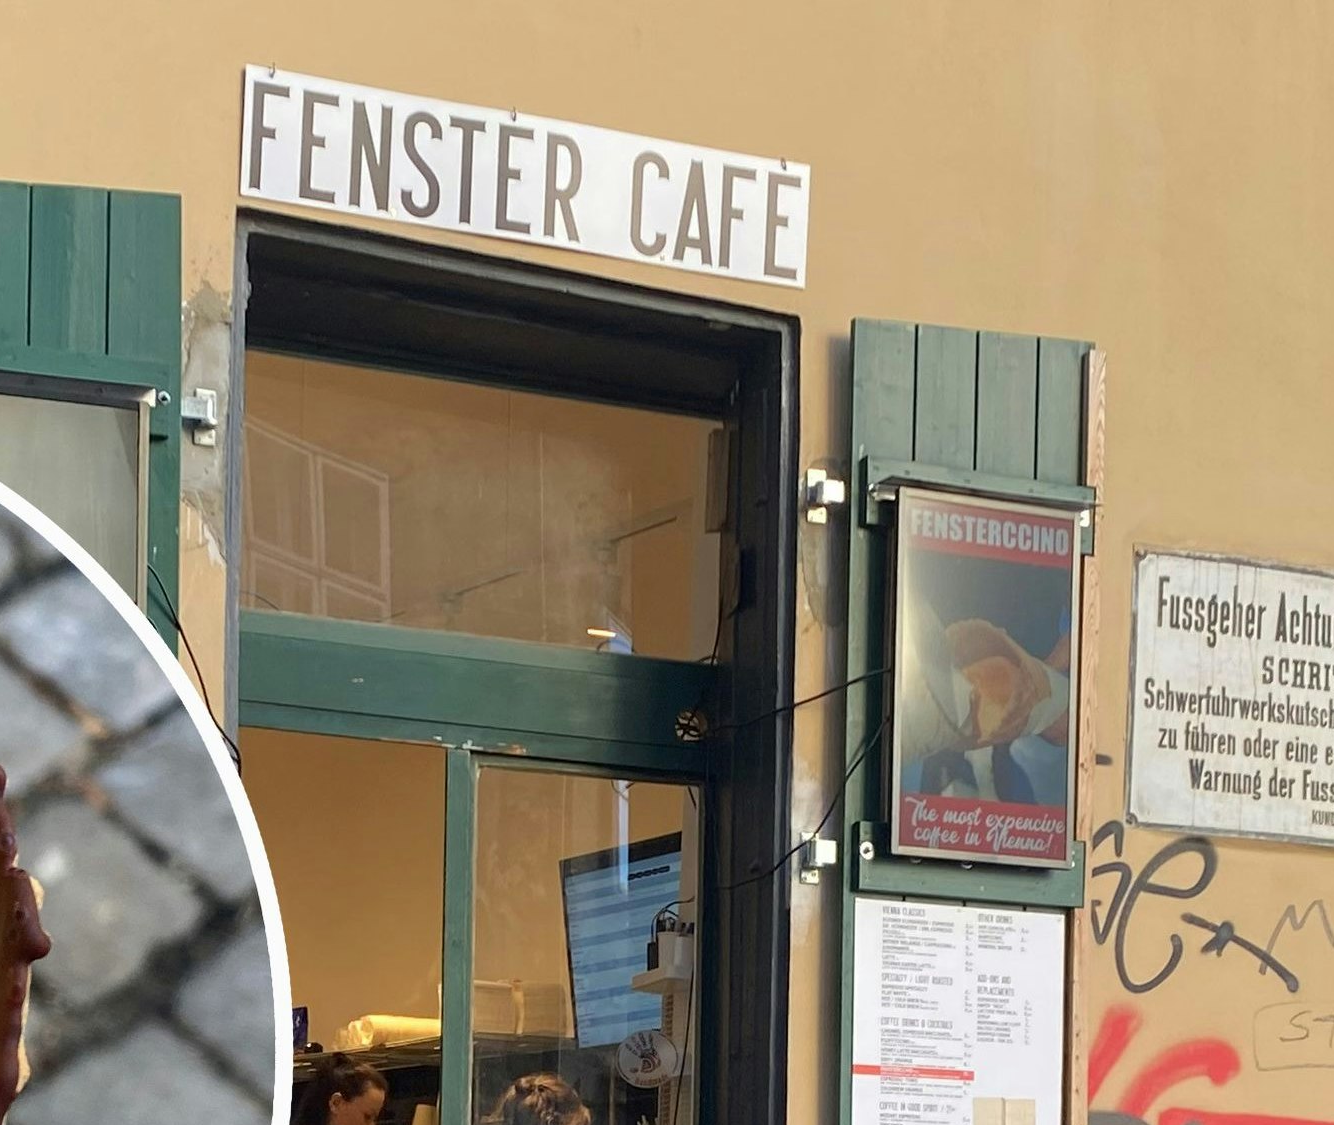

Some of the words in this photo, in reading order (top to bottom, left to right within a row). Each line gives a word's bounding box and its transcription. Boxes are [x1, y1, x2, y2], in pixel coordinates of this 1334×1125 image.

[249, 82, 584, 243] FENSTER
[911, 508, 1069, 556] FENSTERCCINO
[1157, 576, 1267, 648] Fussgeher
[1158, 728, 1178, 750] zu
[1185, 721, 1236, 755] führen
[1243, 728, 1279, 760] oder
[1286, 737, 1318, 764] eine
[1189, 759, 1262, 800] Warnung
[1269, 767, 1295, 799] der
[905, 796, 939, 827] The
[943, 807, 983, 825] most
[913, 825, 960, 848] coffee
[964, 826, 982, 846] in
